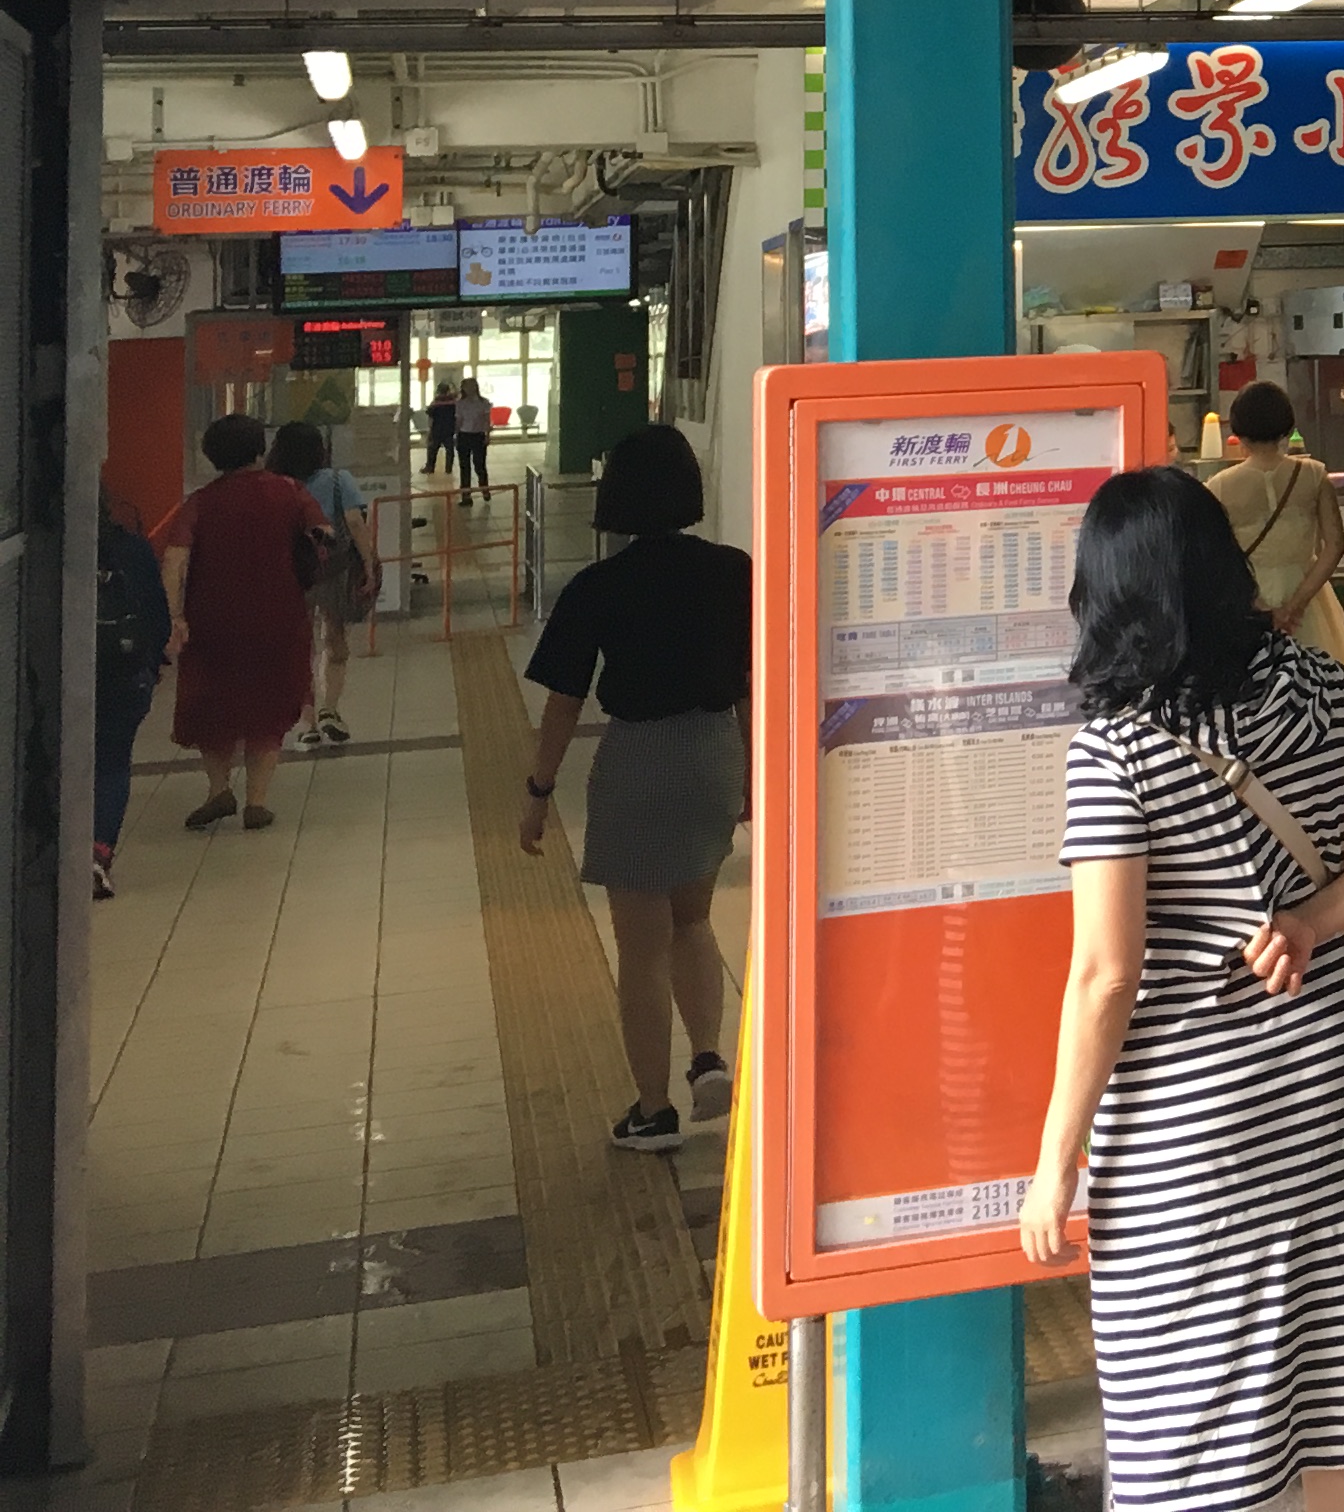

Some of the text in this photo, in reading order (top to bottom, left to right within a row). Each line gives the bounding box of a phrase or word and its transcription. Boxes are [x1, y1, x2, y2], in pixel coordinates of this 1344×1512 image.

[170, 165, 312, 196] 普通渡輪
[167, 199, 315, 218] ORDINARY FERRY
[890, 433, 972, 456] 新渡輪
[889, 455, 968, 467] FIRST FERRY
[875, 486, 946, 503] 中環 CENTRAL
[1010, 480, 1045, 495] CHEUNG
[1047, 479, 1073, 493] CHAU
[966, 693, 993, 707] INTER
[995, 691, 1033, 705] ISLANDS
[971, 1182, 1010, 1202] 2131
[971, 1201, 1010, 1221] 2131
[748, 1352, 778, 1371] WET
